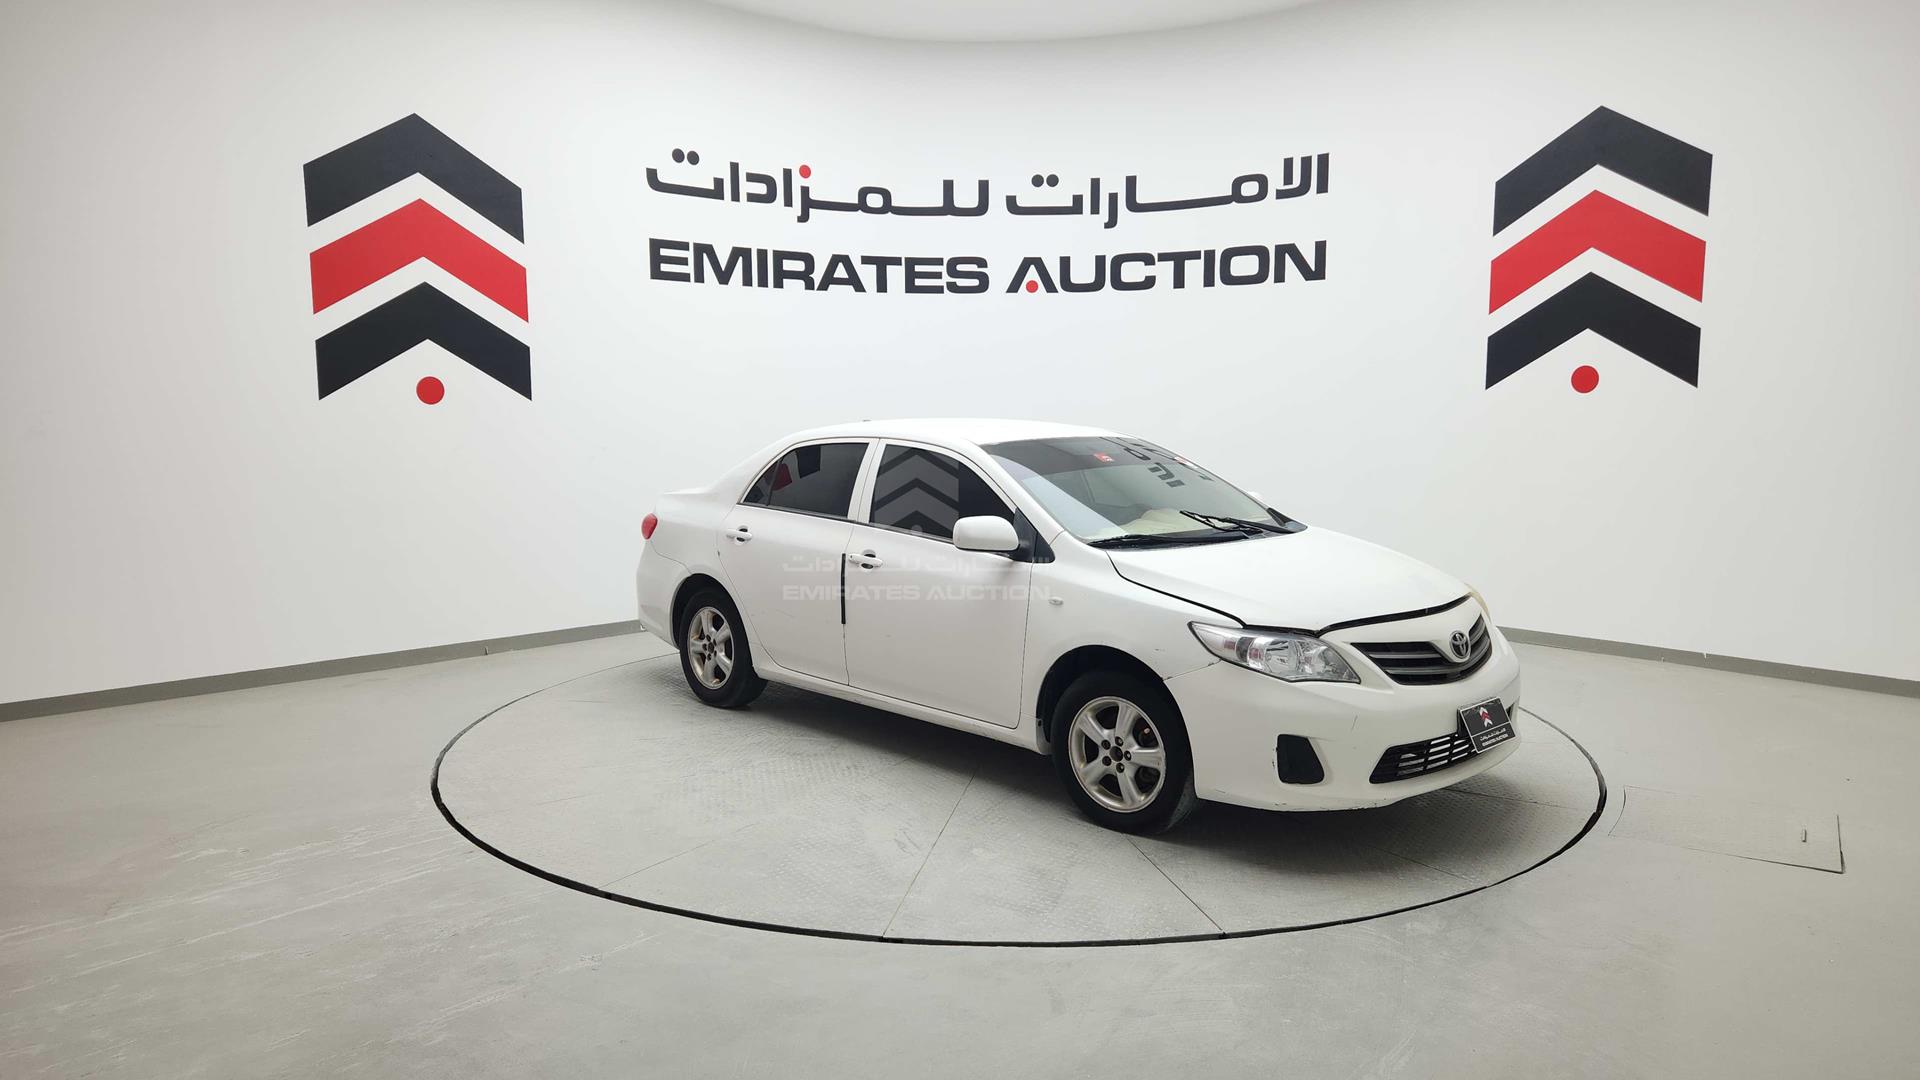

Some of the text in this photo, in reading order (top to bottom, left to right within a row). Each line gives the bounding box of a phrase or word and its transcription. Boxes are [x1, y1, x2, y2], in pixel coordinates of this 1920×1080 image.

[646, 149, 1329, 229] الامارات للمزادات
[649, 238, 1326, 294] EMIRATES AUCTION
